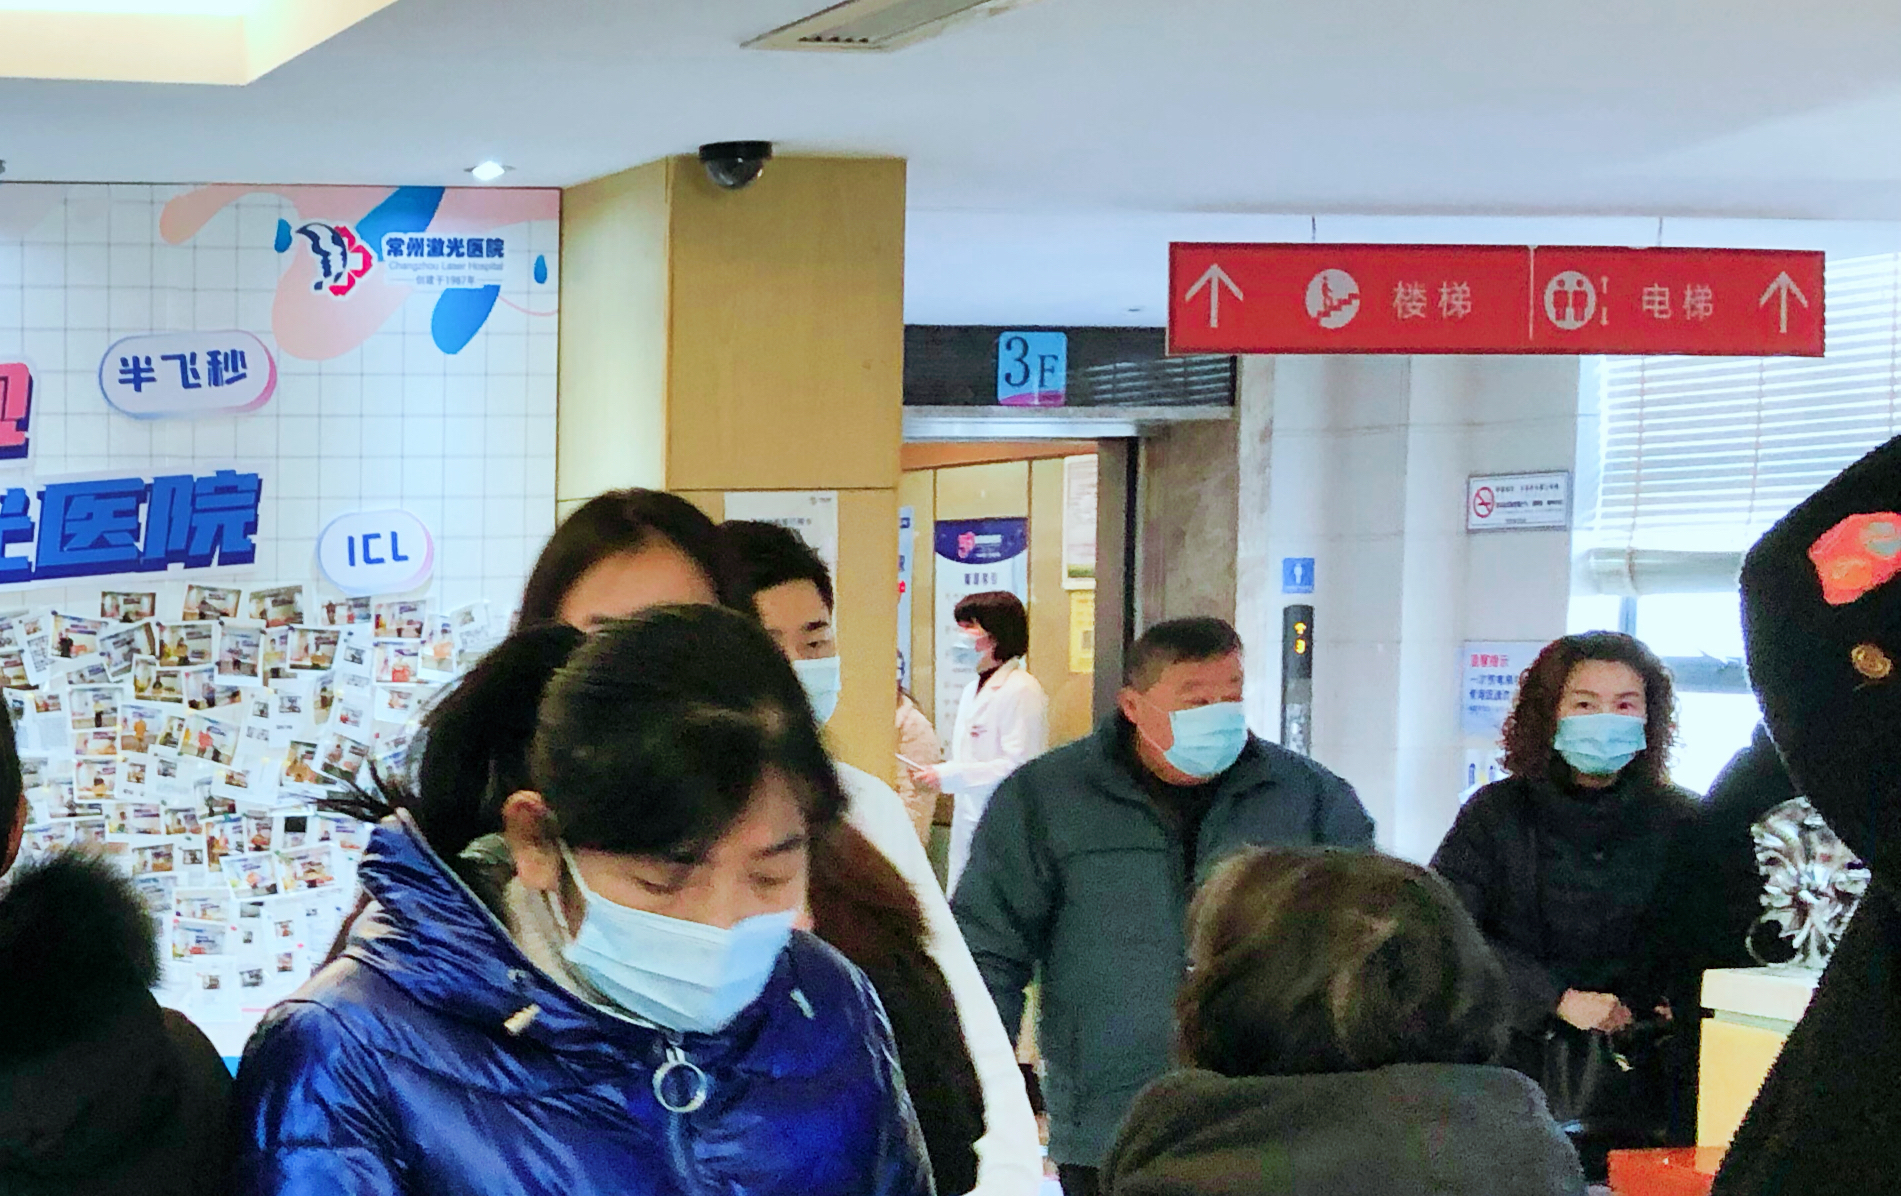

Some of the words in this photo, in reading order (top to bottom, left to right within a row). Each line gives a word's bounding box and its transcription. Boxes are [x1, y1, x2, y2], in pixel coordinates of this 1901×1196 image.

[386, 237, 504, 258] 常州激光医院
[1393, 280, 1471, 319] 楼梯
[1642, 283, 1713, 320] 电梯
[118, 349, 248, 392] 半飞秒
[1005, 336, 1059, 388] 3F
[348, 531, 409, 567] ICL
